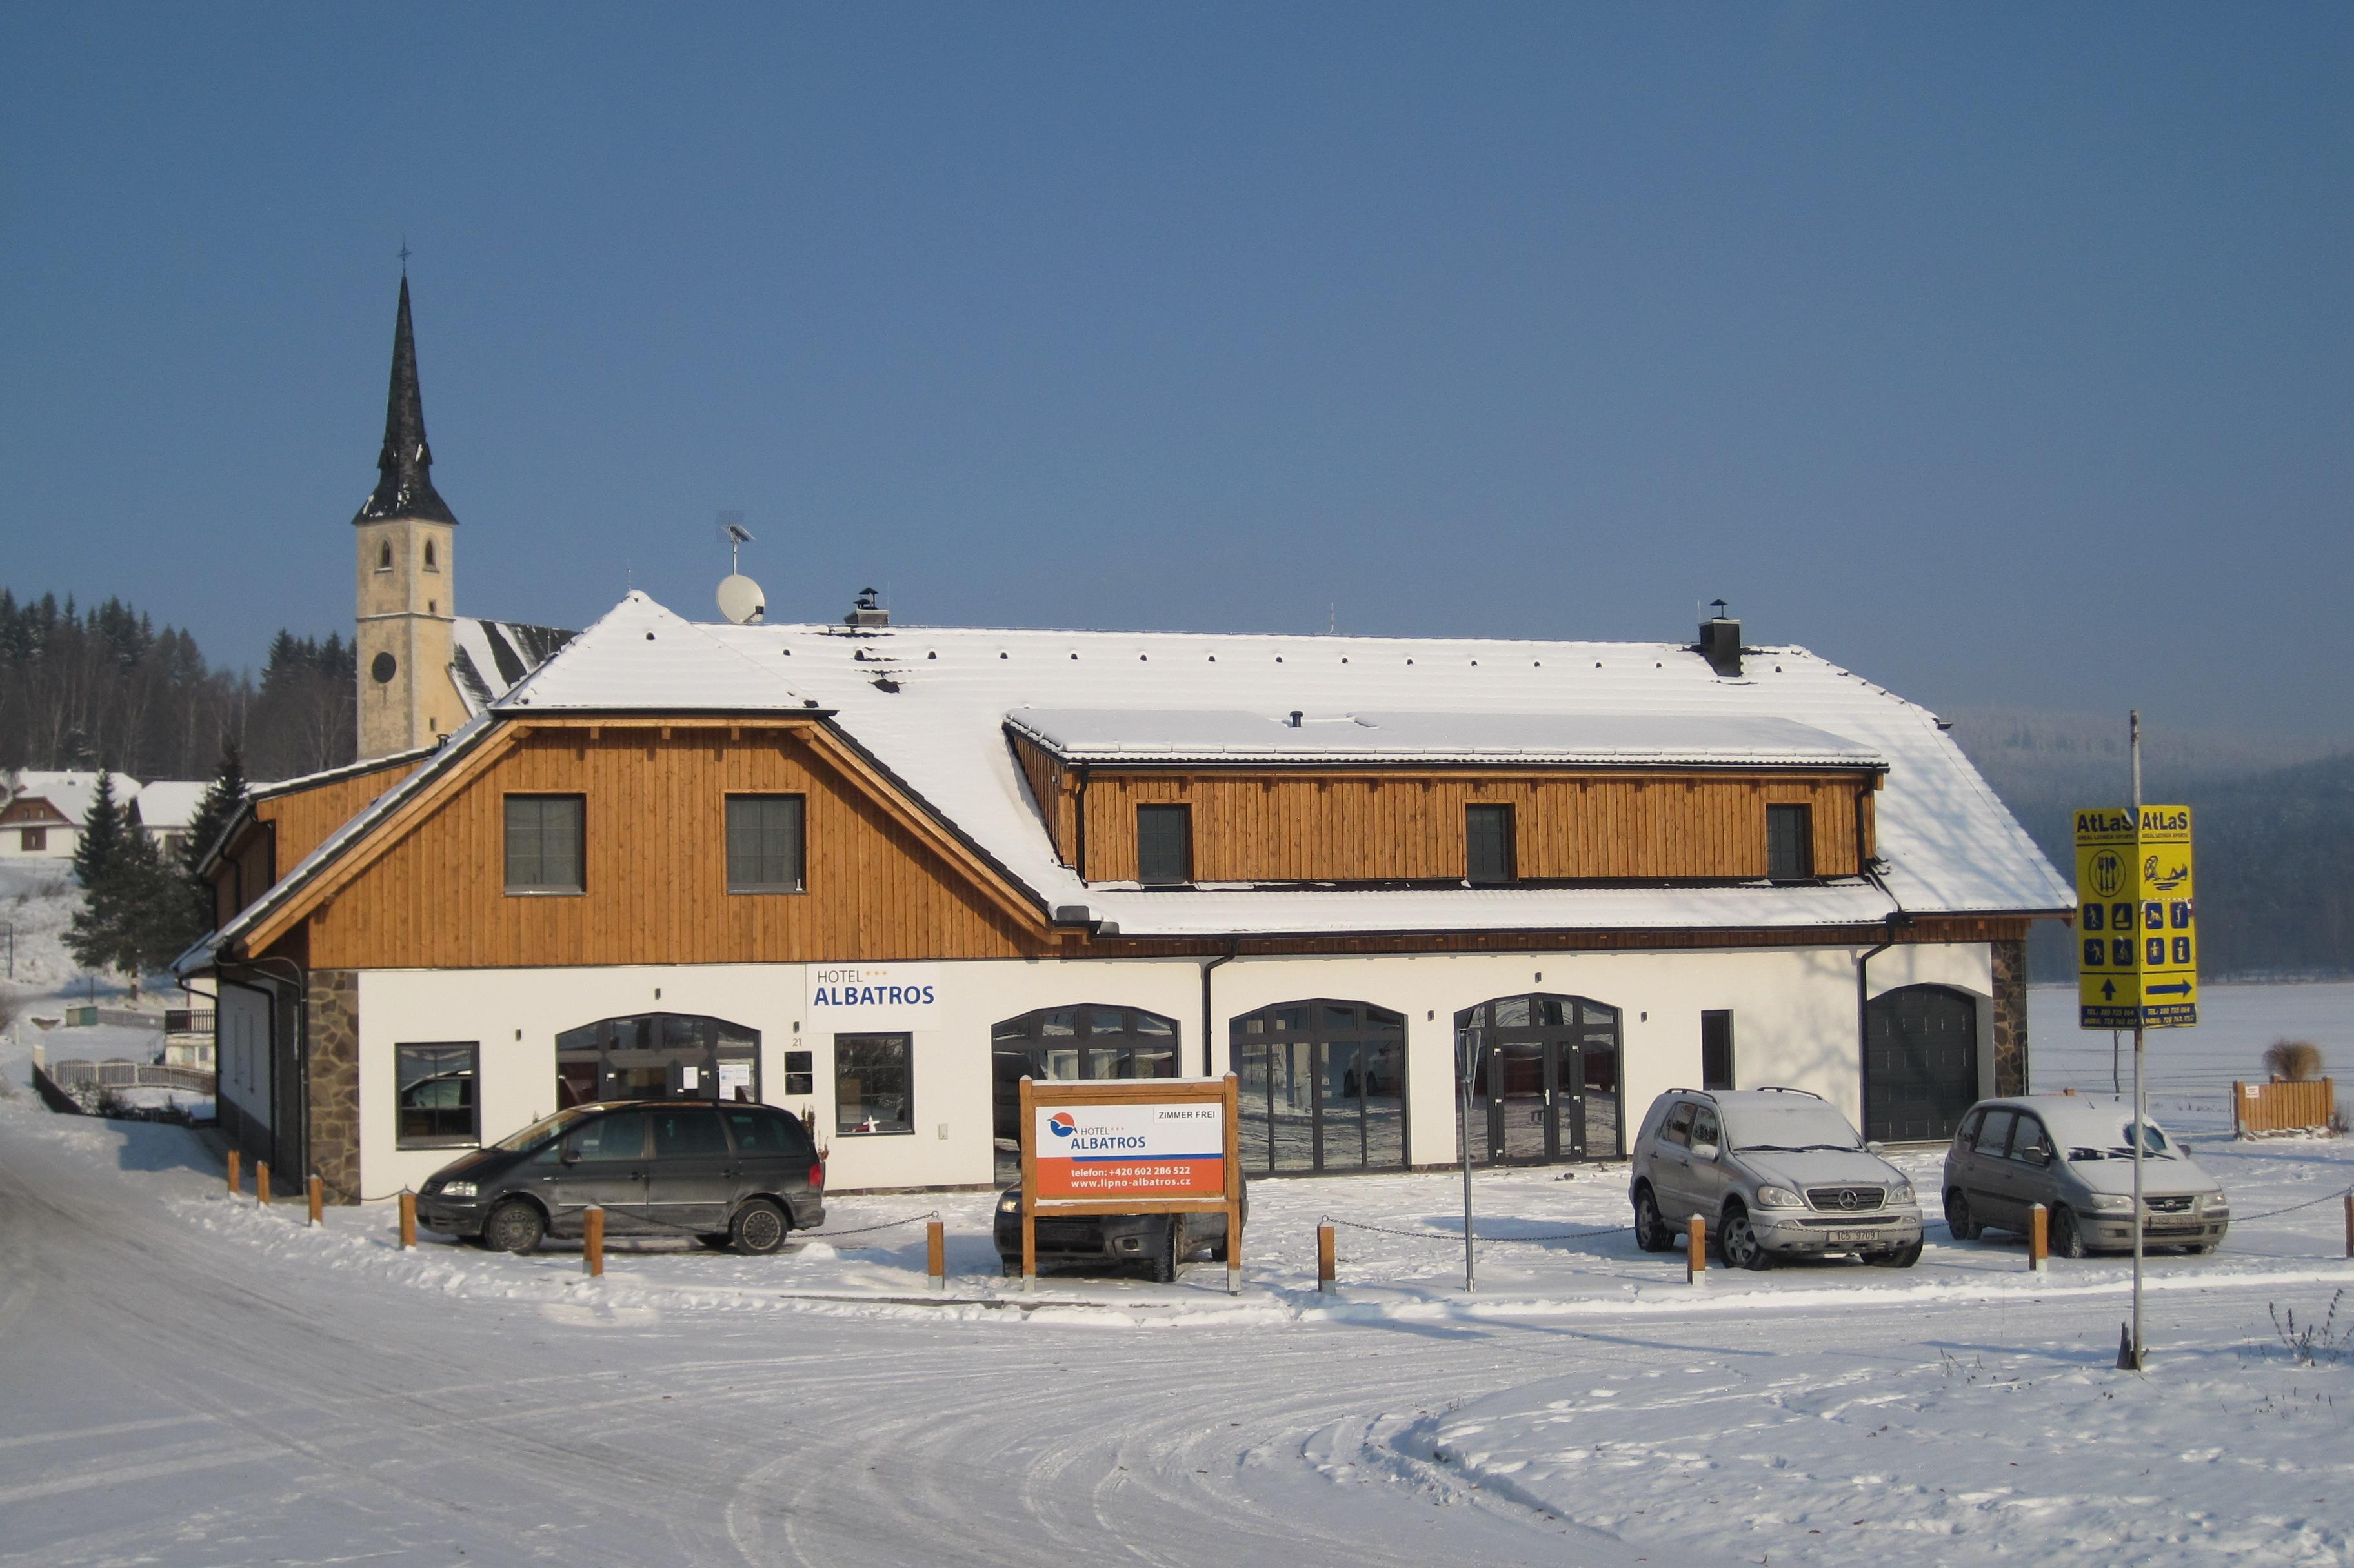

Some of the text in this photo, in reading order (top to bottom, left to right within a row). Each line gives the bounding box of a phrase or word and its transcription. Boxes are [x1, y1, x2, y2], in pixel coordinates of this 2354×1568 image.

[817, 970, 863, 983] HOTEL
[814, 985, 934, 1006] ALBATROS
[792, 1038, 802, 1047] 21
[1081, 1127, 1110, 1136] HOTEL
[1071, 1136, 1146, 1150] ALBATROS
[1071, 1166, 1191, 1177] telefon: +420 602 286 522
[1071, 1178, 1191, 1189] www.lipno-albatros.cz
